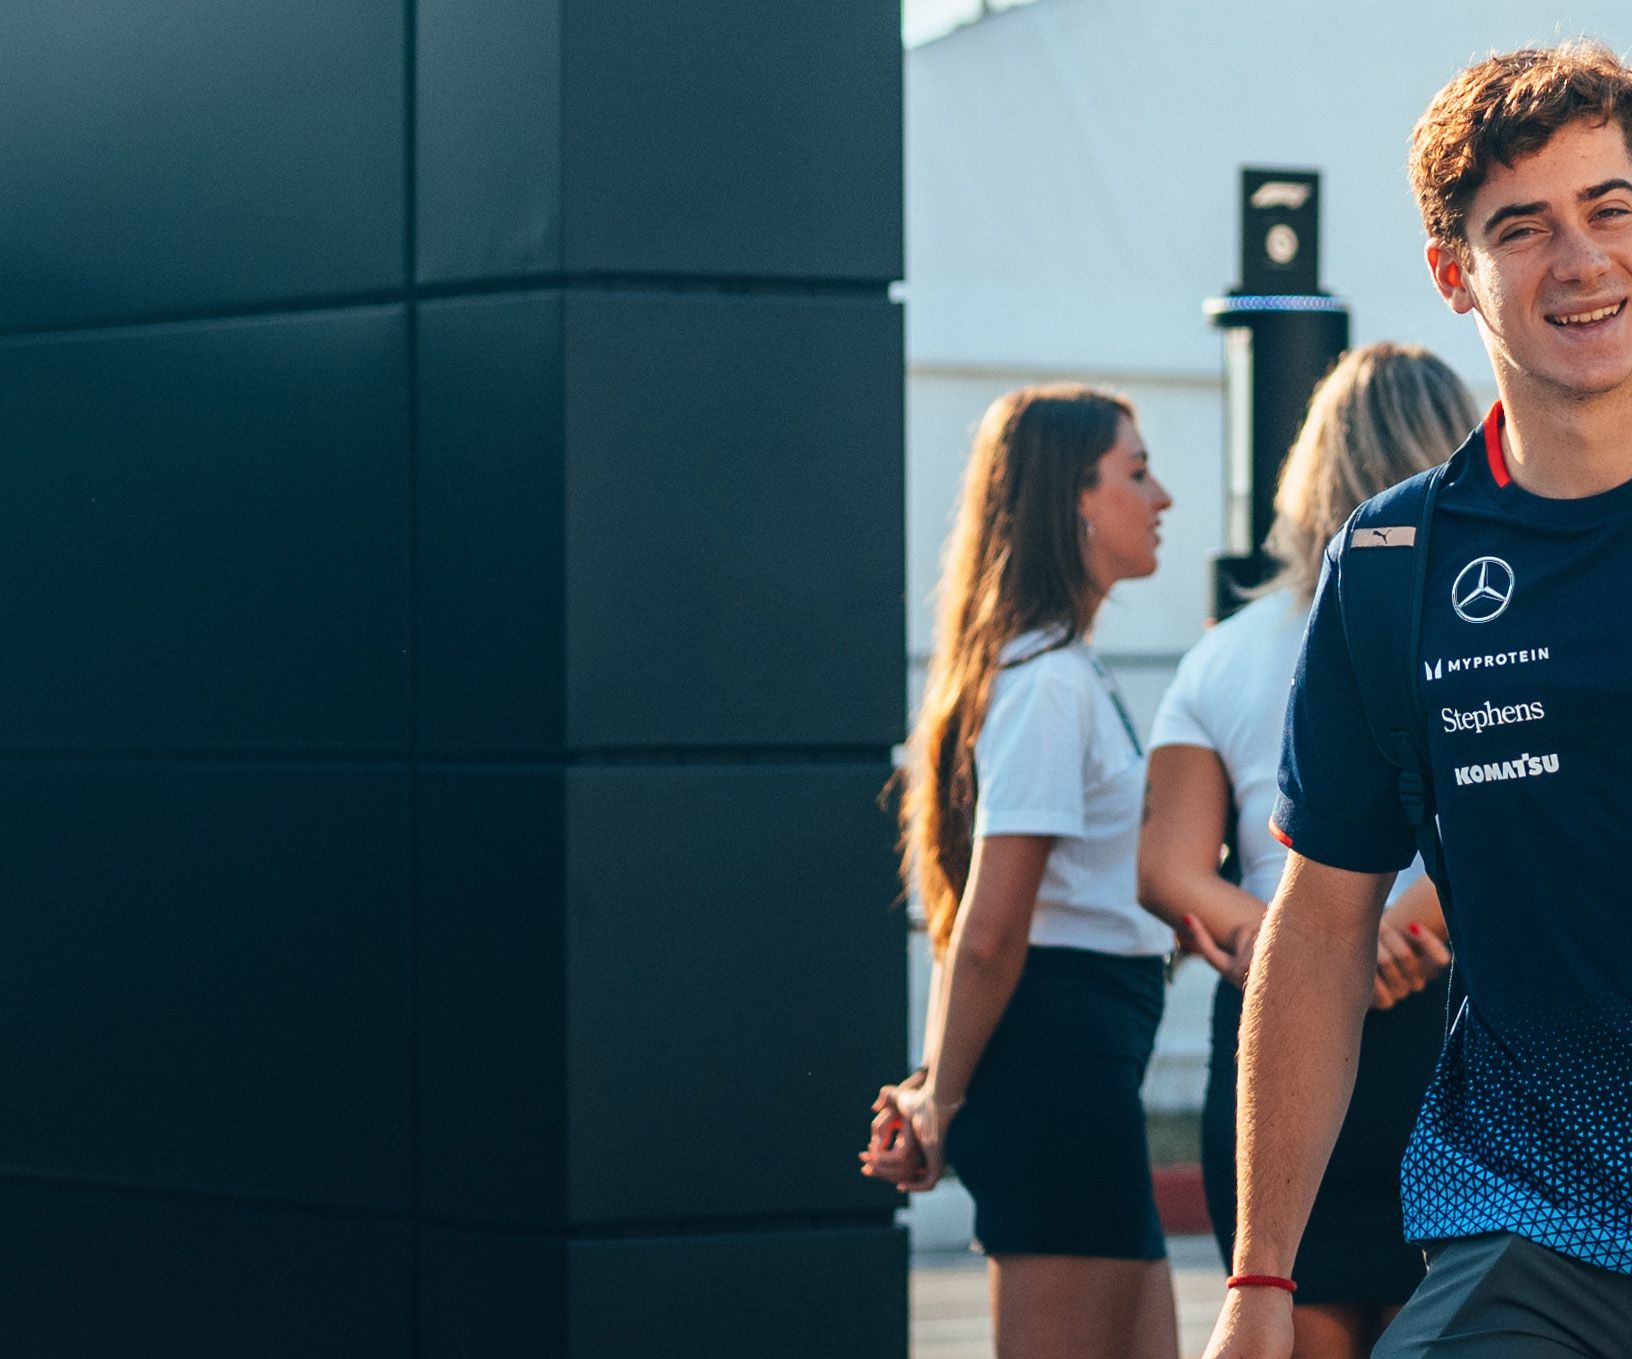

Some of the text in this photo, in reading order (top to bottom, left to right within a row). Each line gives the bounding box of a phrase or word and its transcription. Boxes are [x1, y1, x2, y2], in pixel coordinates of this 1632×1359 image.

[1447, 646, 1550, 673] MYPROTEIN
[1441, 700, 1545, 734] Stephens
[1454, 752, 1560, 786] KOMATSU
